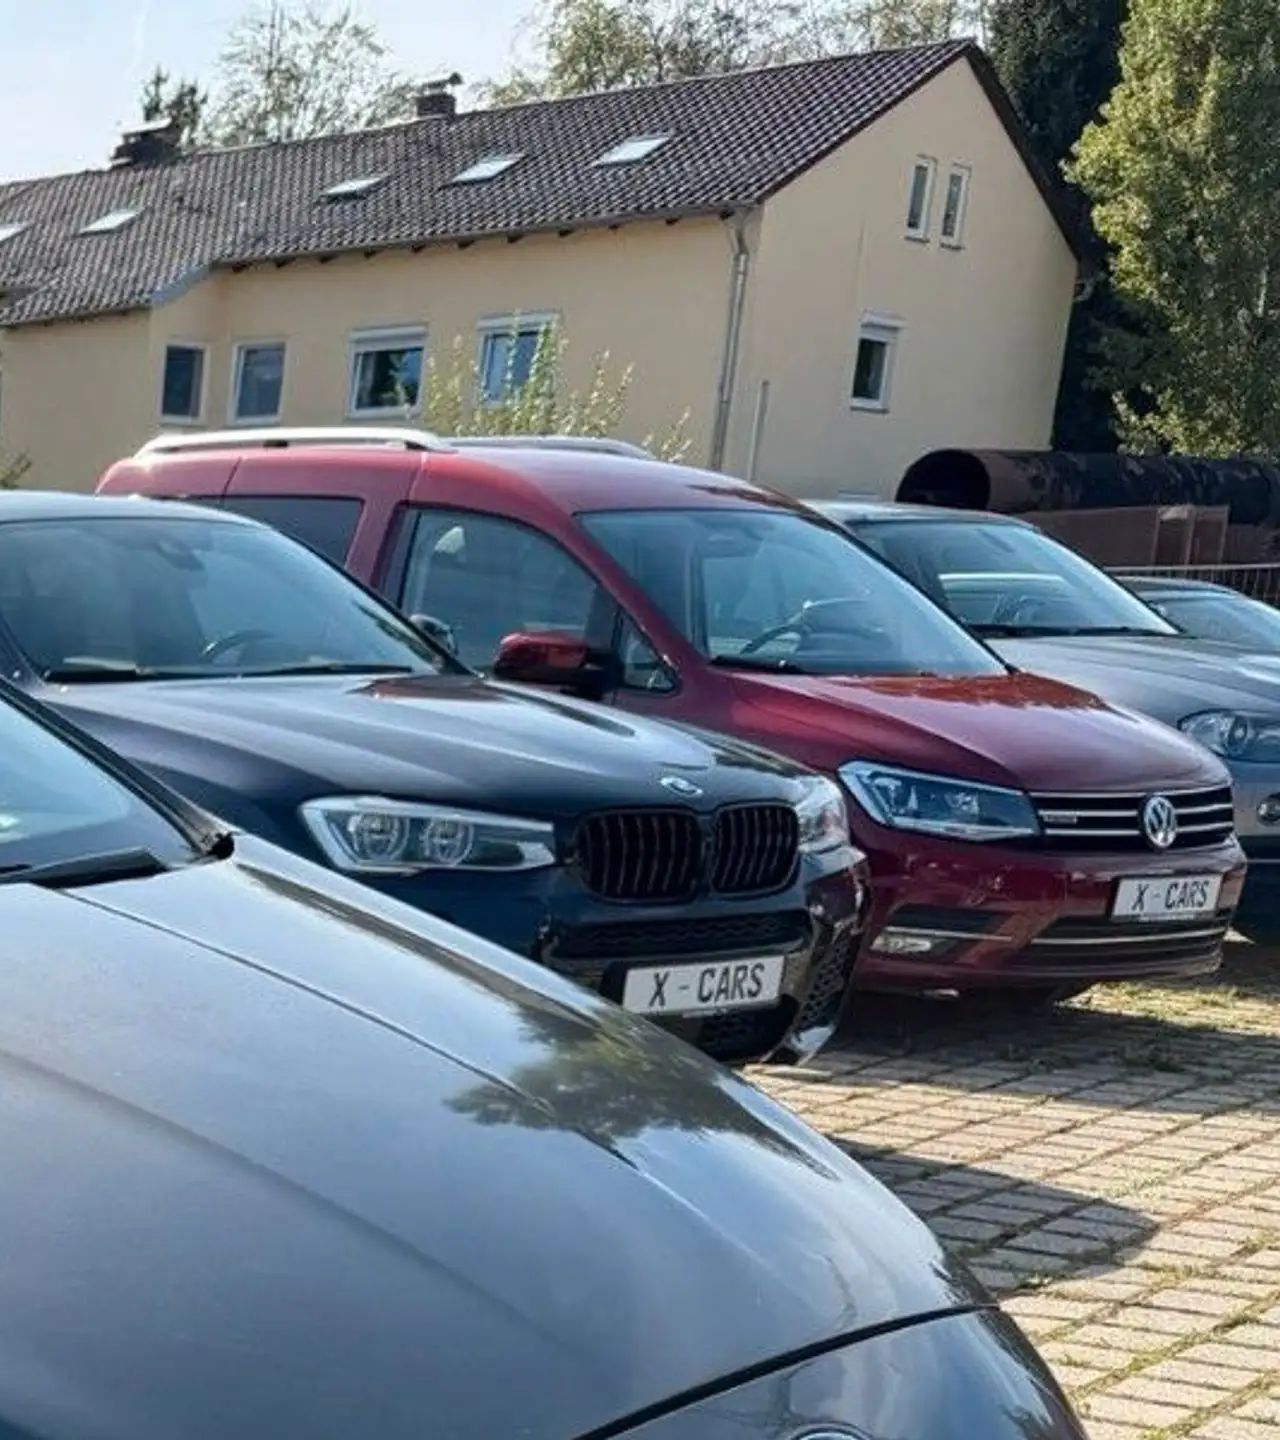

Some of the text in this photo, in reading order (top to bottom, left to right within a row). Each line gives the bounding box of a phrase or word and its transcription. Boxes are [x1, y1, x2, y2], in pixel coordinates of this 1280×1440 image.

[1131, 883, 1150, 911] X
[1164, 880, 1210, 911] CARS
[648, 971, 671, 1007] X
[697, 962, 765, 1003] CARS
